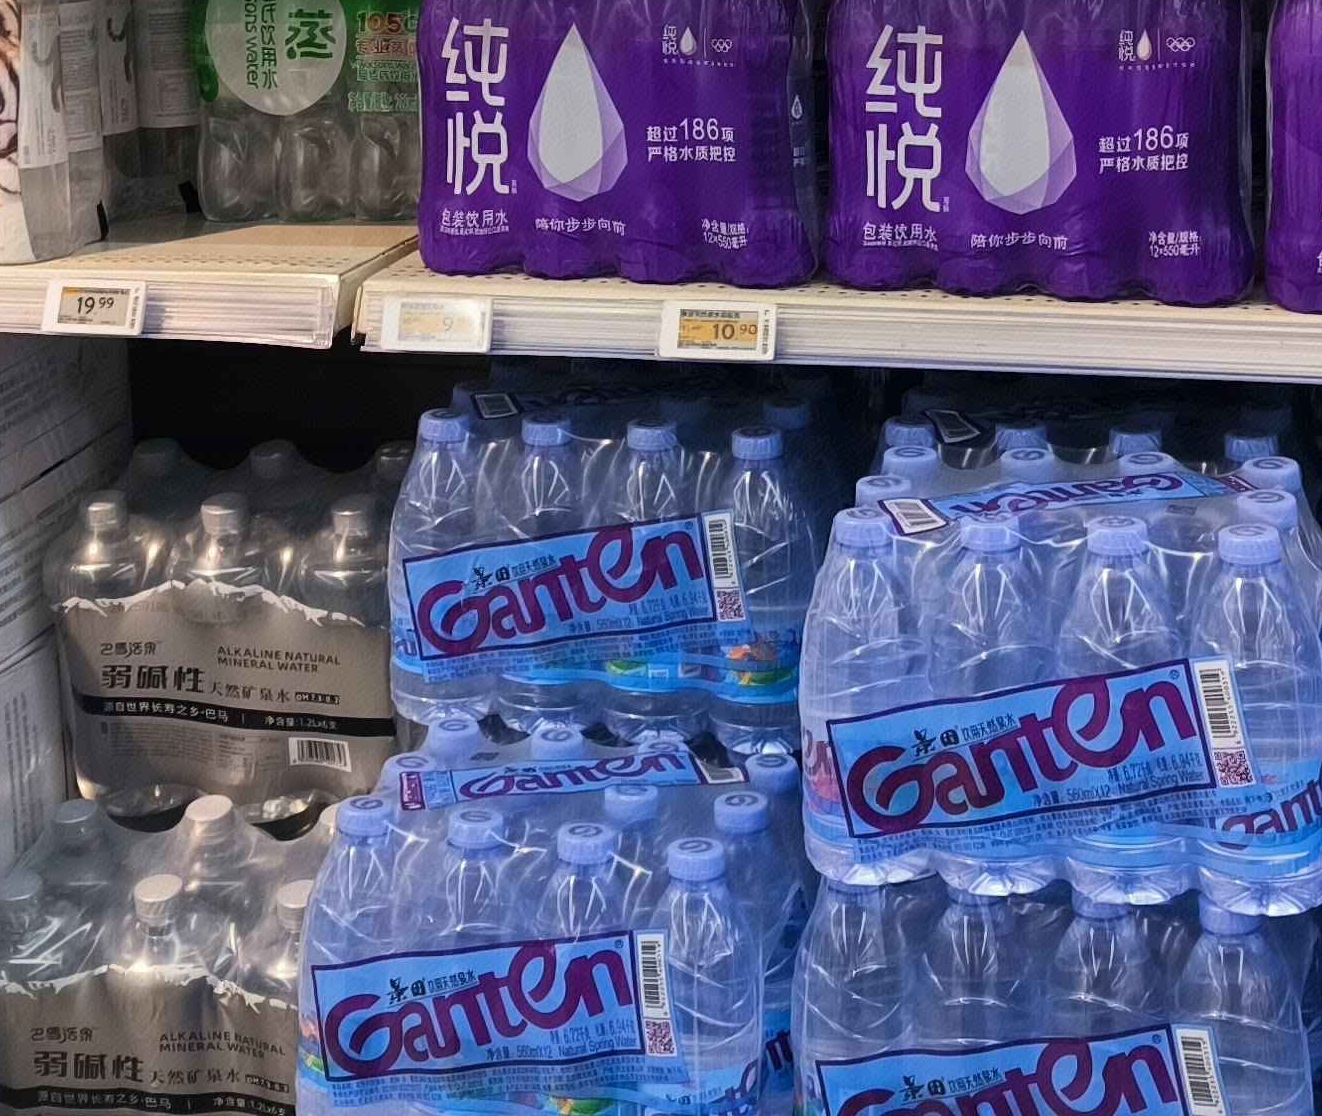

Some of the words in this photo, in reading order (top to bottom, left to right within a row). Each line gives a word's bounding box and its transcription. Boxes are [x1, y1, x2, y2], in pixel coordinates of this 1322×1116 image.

[284, 8, 337, 61] 蒸
[246, 36, 260, 90] water
[440, 17, 510, 196] 纯悦
[864, 24, 943, 213] 纯悦
[646, 117, 736, 144] 超过186项
[1098, 125, 1190, 153] 超过186项
[646, 143, 737, 164] 严格水质把控
[1098, 150, 1190, 173] 严格水质把控
[440, 207, 509, 228] 包装饮用水
[862, 221, 938, 243] 包装饮用水
[970, 231, 1069, 251] 陪你步步向前
[417, 524, 705, 655] Ganten
[217, 646, 281, 661] ALKALINE
[285, 651, 341, 665] NATURAL
[217, 656, 275, 670] MINERAL
[278, 660, 319, 673] WATER
[101, 664, 205, 694] 弱碱性
[208, 681, 291, 703] 天然矿泉水
[846, 678, 1198, 832] Ganten
[324, 941, 634, 1078] Ganten
[158, 1031, 231, 1043] ALKALINE
[234, 1033, 287, 1056] NATURAL
[158, 1042, 224, 1053] MINERAL
[227, 1042, 266, 1060] WATER
[33, 1050, 145, 1083] 弱碱性
[149, 1067, 241, 1086] 天然矿泉水
